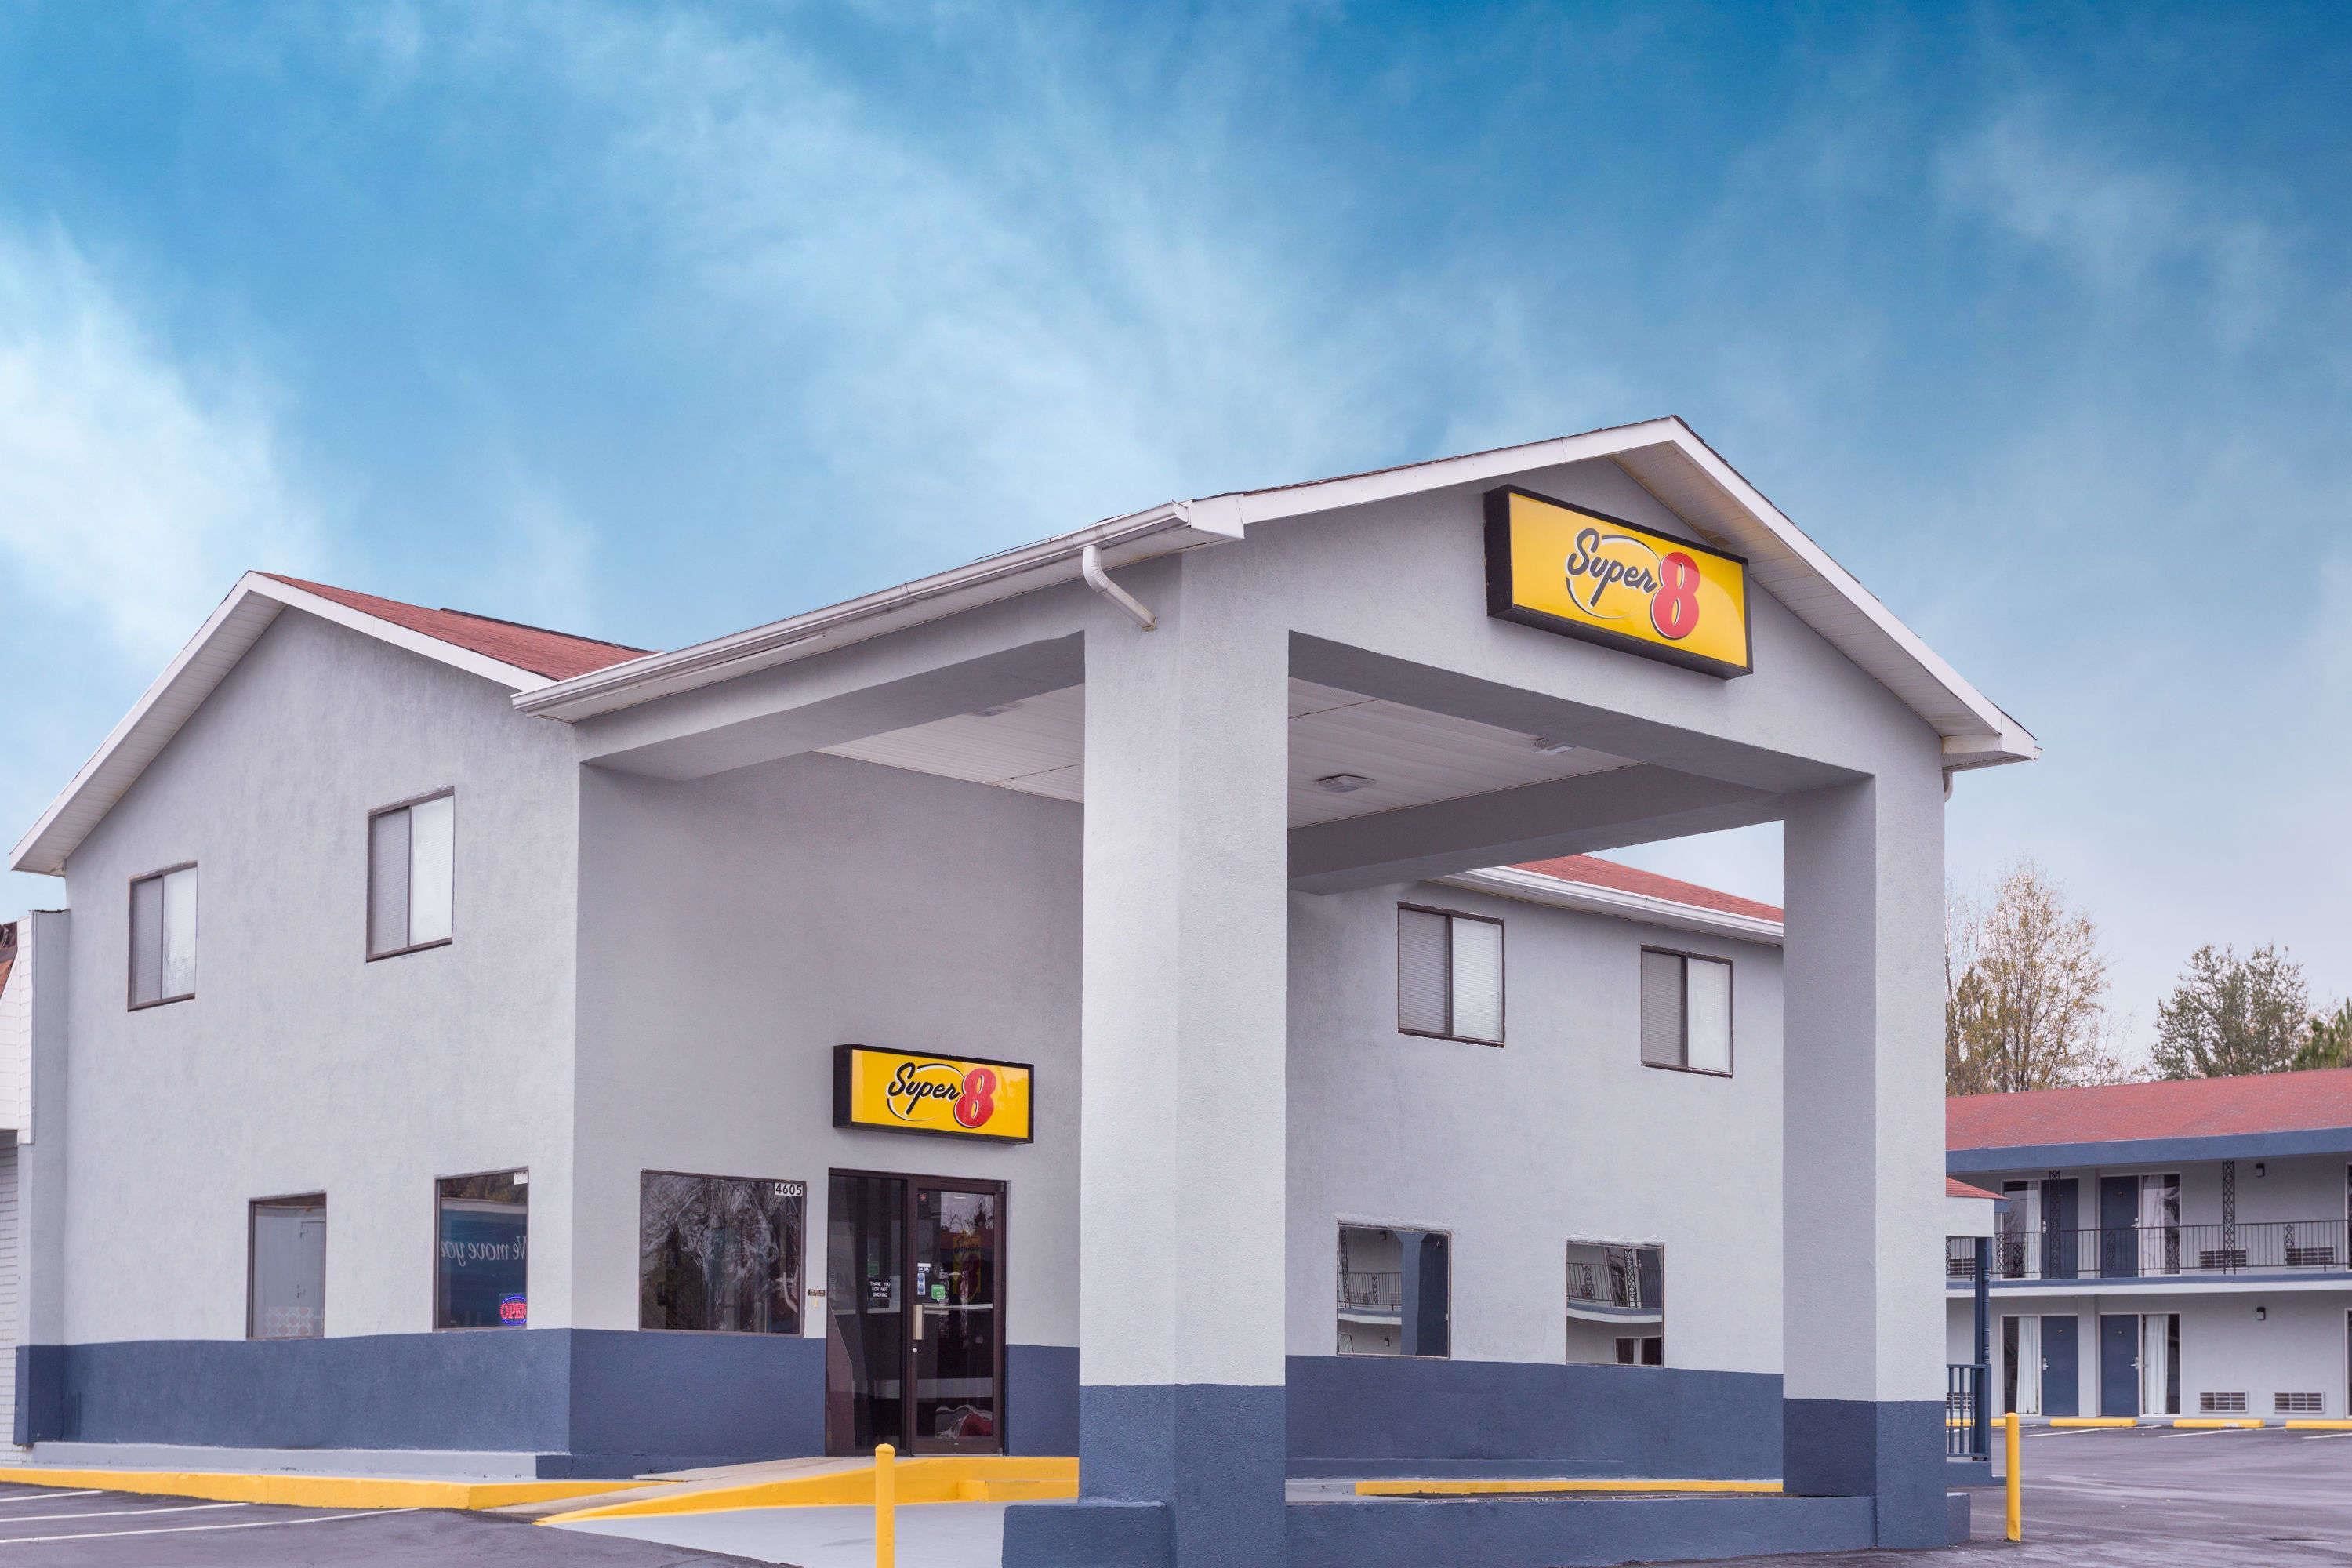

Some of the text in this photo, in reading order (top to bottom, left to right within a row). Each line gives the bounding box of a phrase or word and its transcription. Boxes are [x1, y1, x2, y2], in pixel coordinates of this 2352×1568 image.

[1567, 528, 1700, 640] Super 8
[887, 1062, 997, 1128] Super 8
[775, 1184, 802, 1195] 4605
